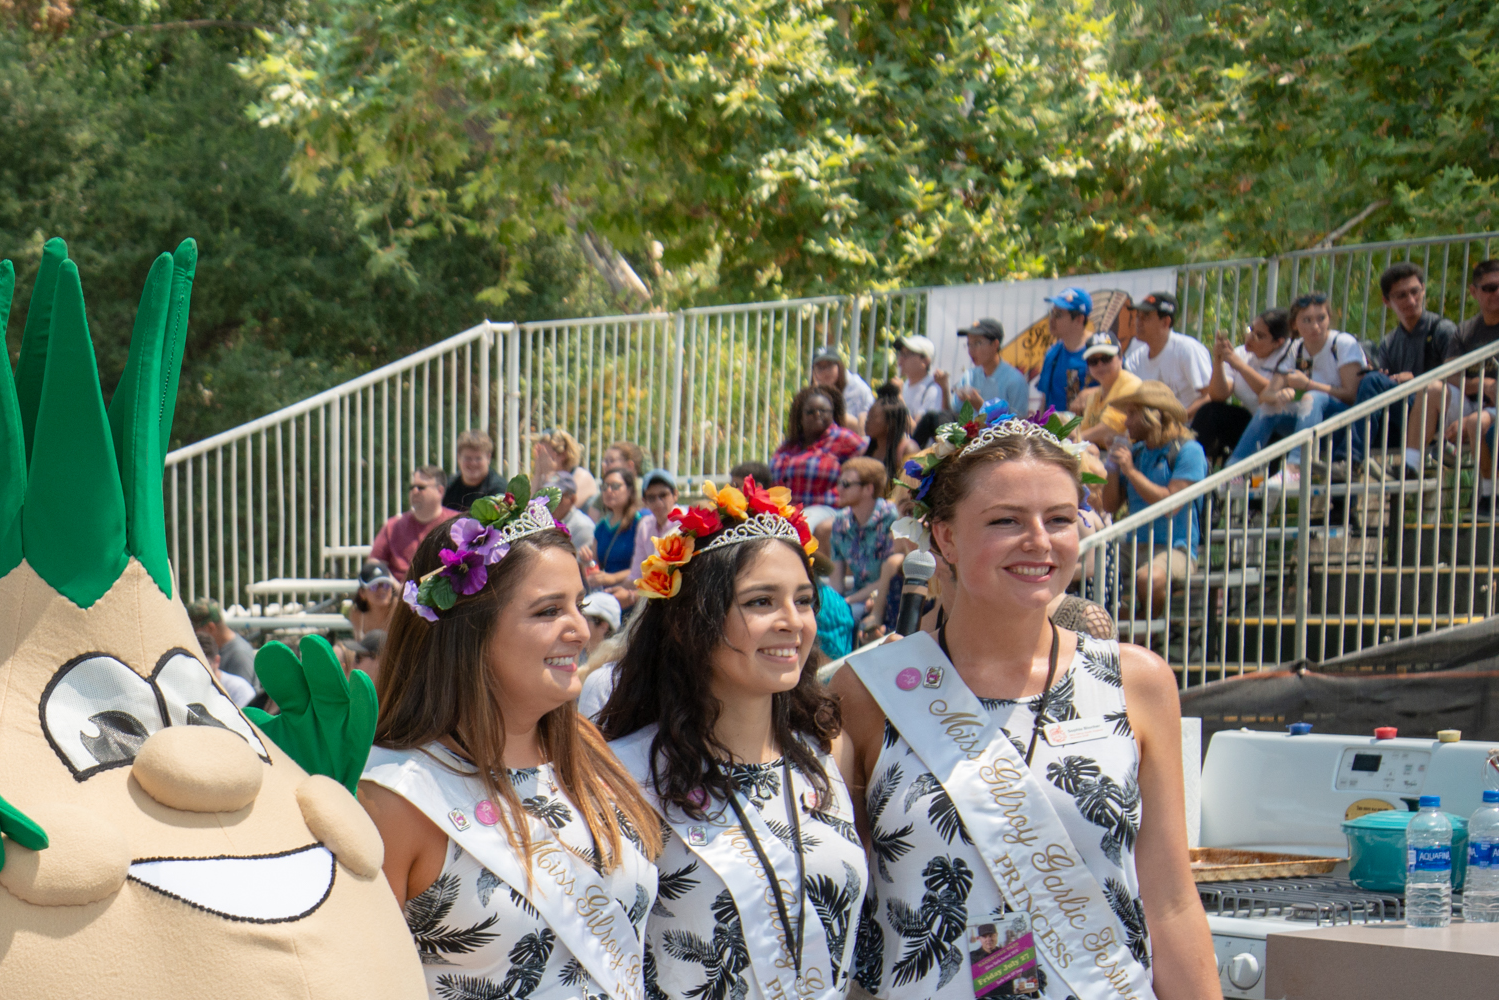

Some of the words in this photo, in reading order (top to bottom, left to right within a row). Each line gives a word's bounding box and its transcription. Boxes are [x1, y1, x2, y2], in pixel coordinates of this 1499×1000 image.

[929, 699, 987, 761] Miss
[978, 757, 1033, 848] Gilroy
[1031, 842, 1089, 931] Garlic
[577, 884, 625, 972] Gilroy
[992, 853, 1074, 970] PRINCESS
[977, 969, 1002, 986] Friday
[1003, 959, 1019, 971] July
[1019, 953, 1029, 961] 27
